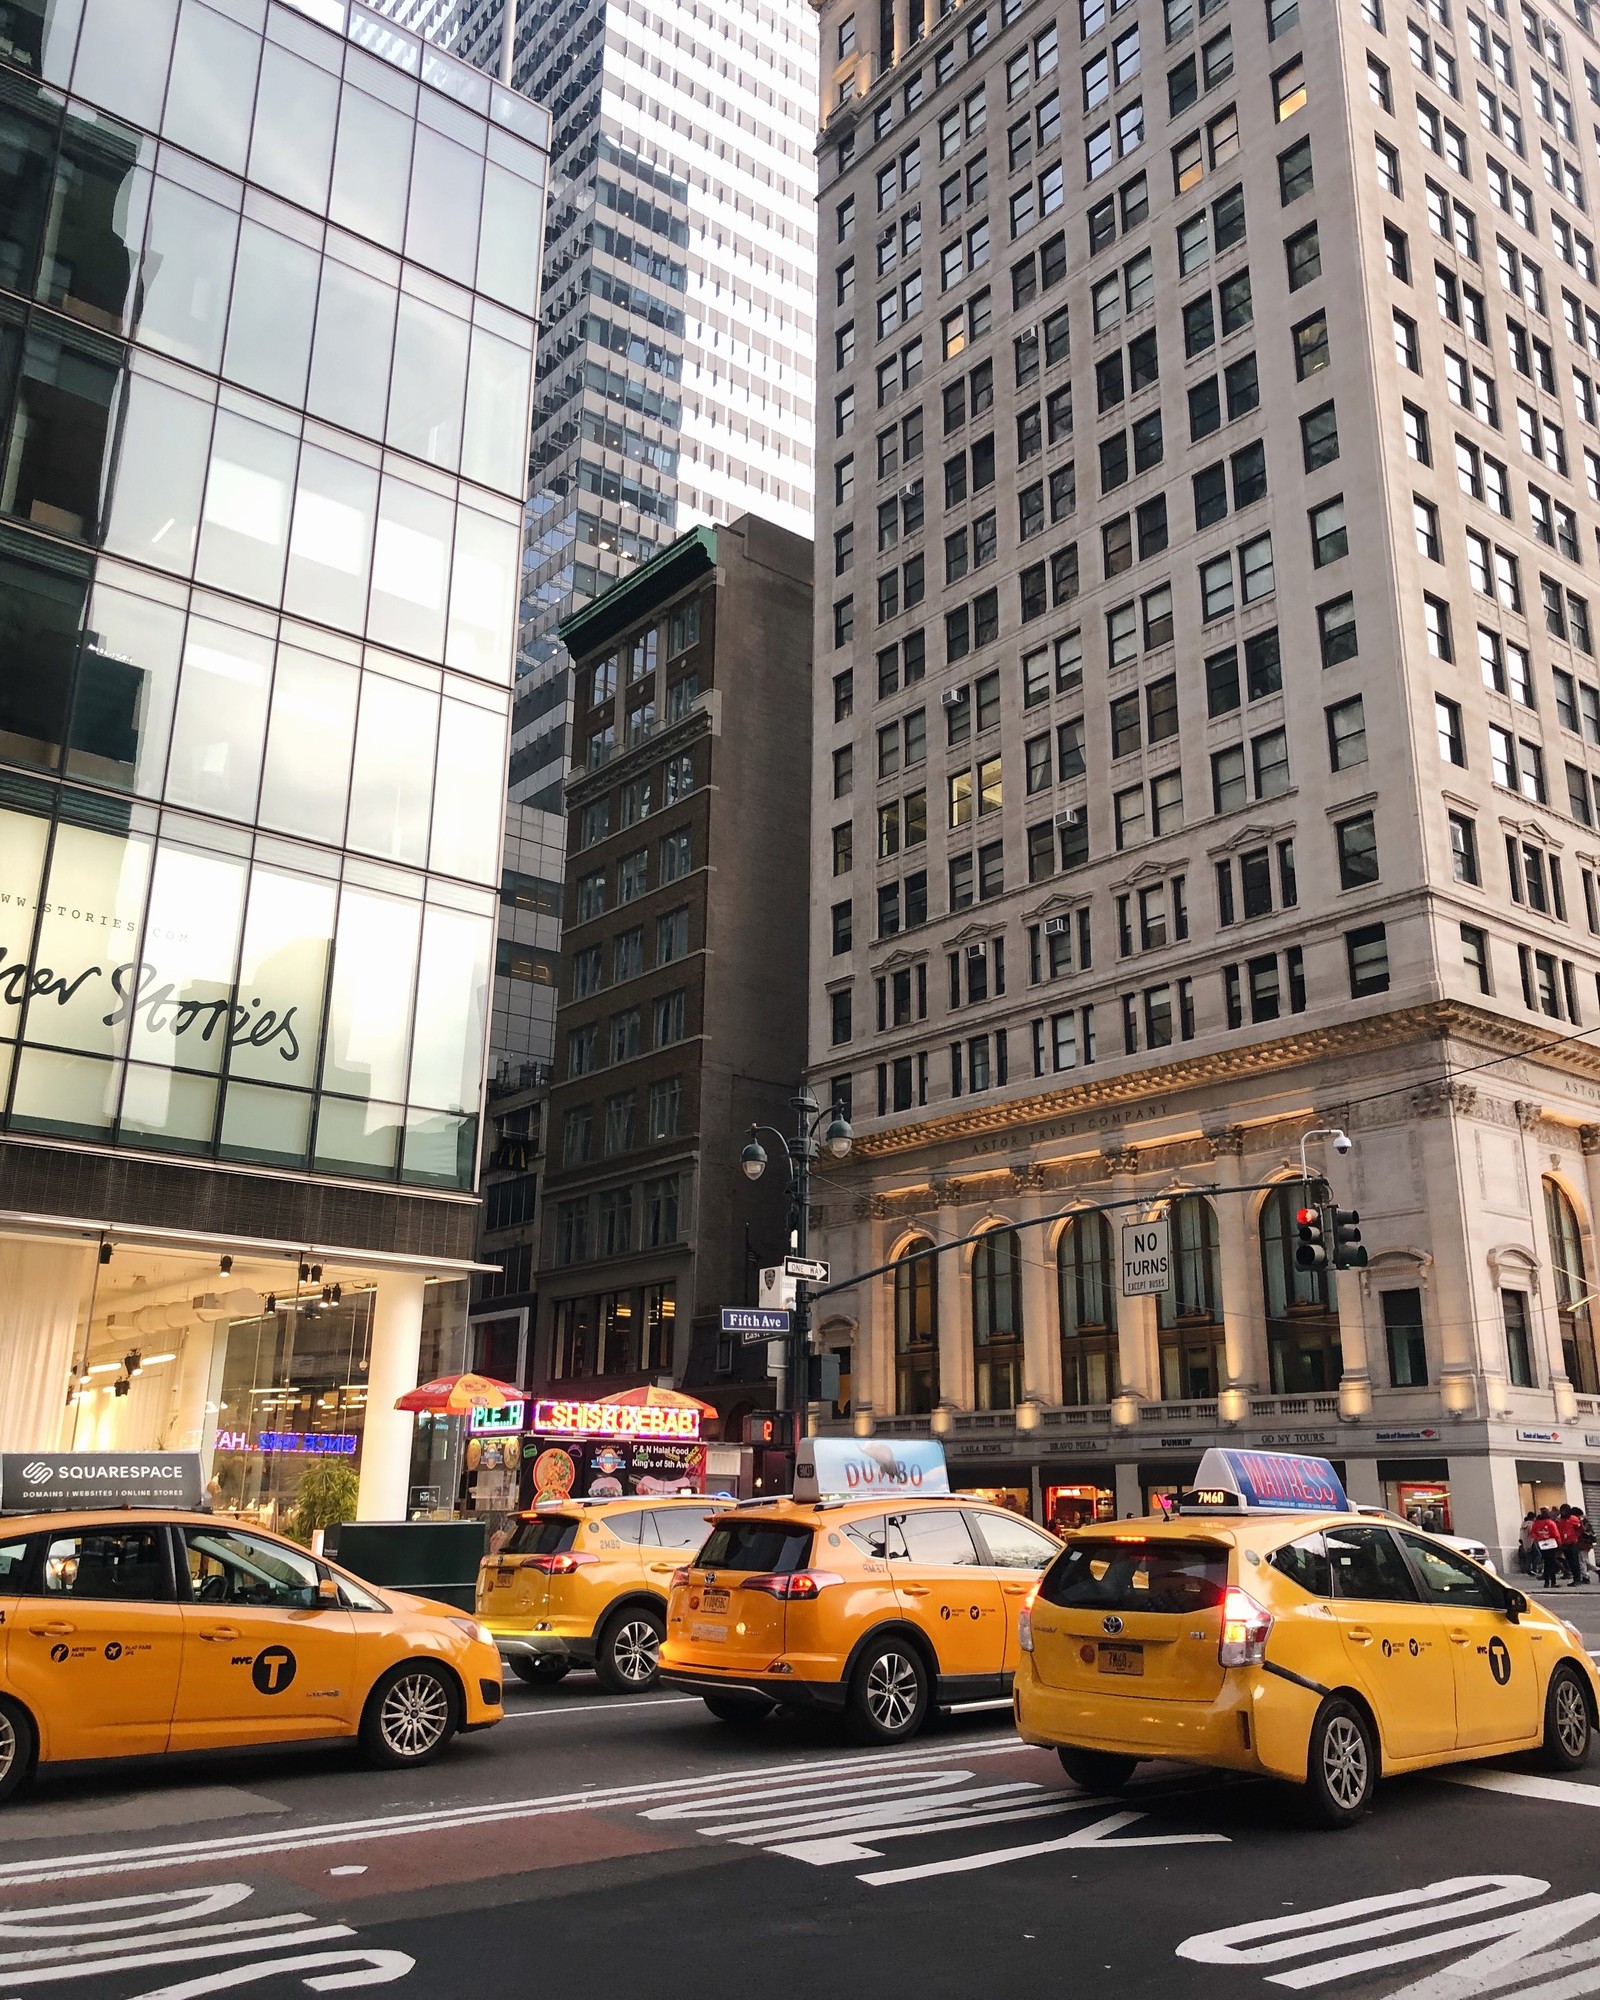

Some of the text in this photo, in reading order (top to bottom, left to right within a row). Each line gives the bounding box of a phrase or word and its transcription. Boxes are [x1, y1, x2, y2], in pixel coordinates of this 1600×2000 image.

[103, 963, 299, 1061] Stories
[1564, 1081, 1600, 1100] ASTO
[972, 1136, 1018, 1154] ASTOR
[1088, 1104, 1168, 1129] COMPANY
[1134, 1232, 1157, 1253] NO
[791, 1263, 823, 1275] ONE WAY
[1125, 1257, 1167, 1277] TURNS
[1128, 1278, 1164, 1291] EXCEPT BUSES
[729, 1313, 781, 1328] Fifth Ave
[622, 1407, 693, 1434] KEBAB
[1161, 1438, 1192, 1447] DUNKIN'
[1261, 1433, 1325, 1443] GO NY TOURS
[632, 1445, 638, 1453] F
[639, 1445, 645, 1453] &
[653, 1445, 670, 1454] Halal
[671, 1446, 689, 1454] Food
[1050, 1441, 1097, 1450] BRAVO PIZZA
[632, 1459, 654, 1469] King's
[655, 1460, 663, 1468] of
[664, 1460, 674, 1468] 5th
[58, 1466, 183, 1479] SQUARESPACE
[1237, 1453, 1337, 1504] WAITRESS
[23, 1490, 63, 1498] DOMAINS
[1197, 1491, 1224, 1504] 7M60
[231, 1656, 253, 1665] NYC
